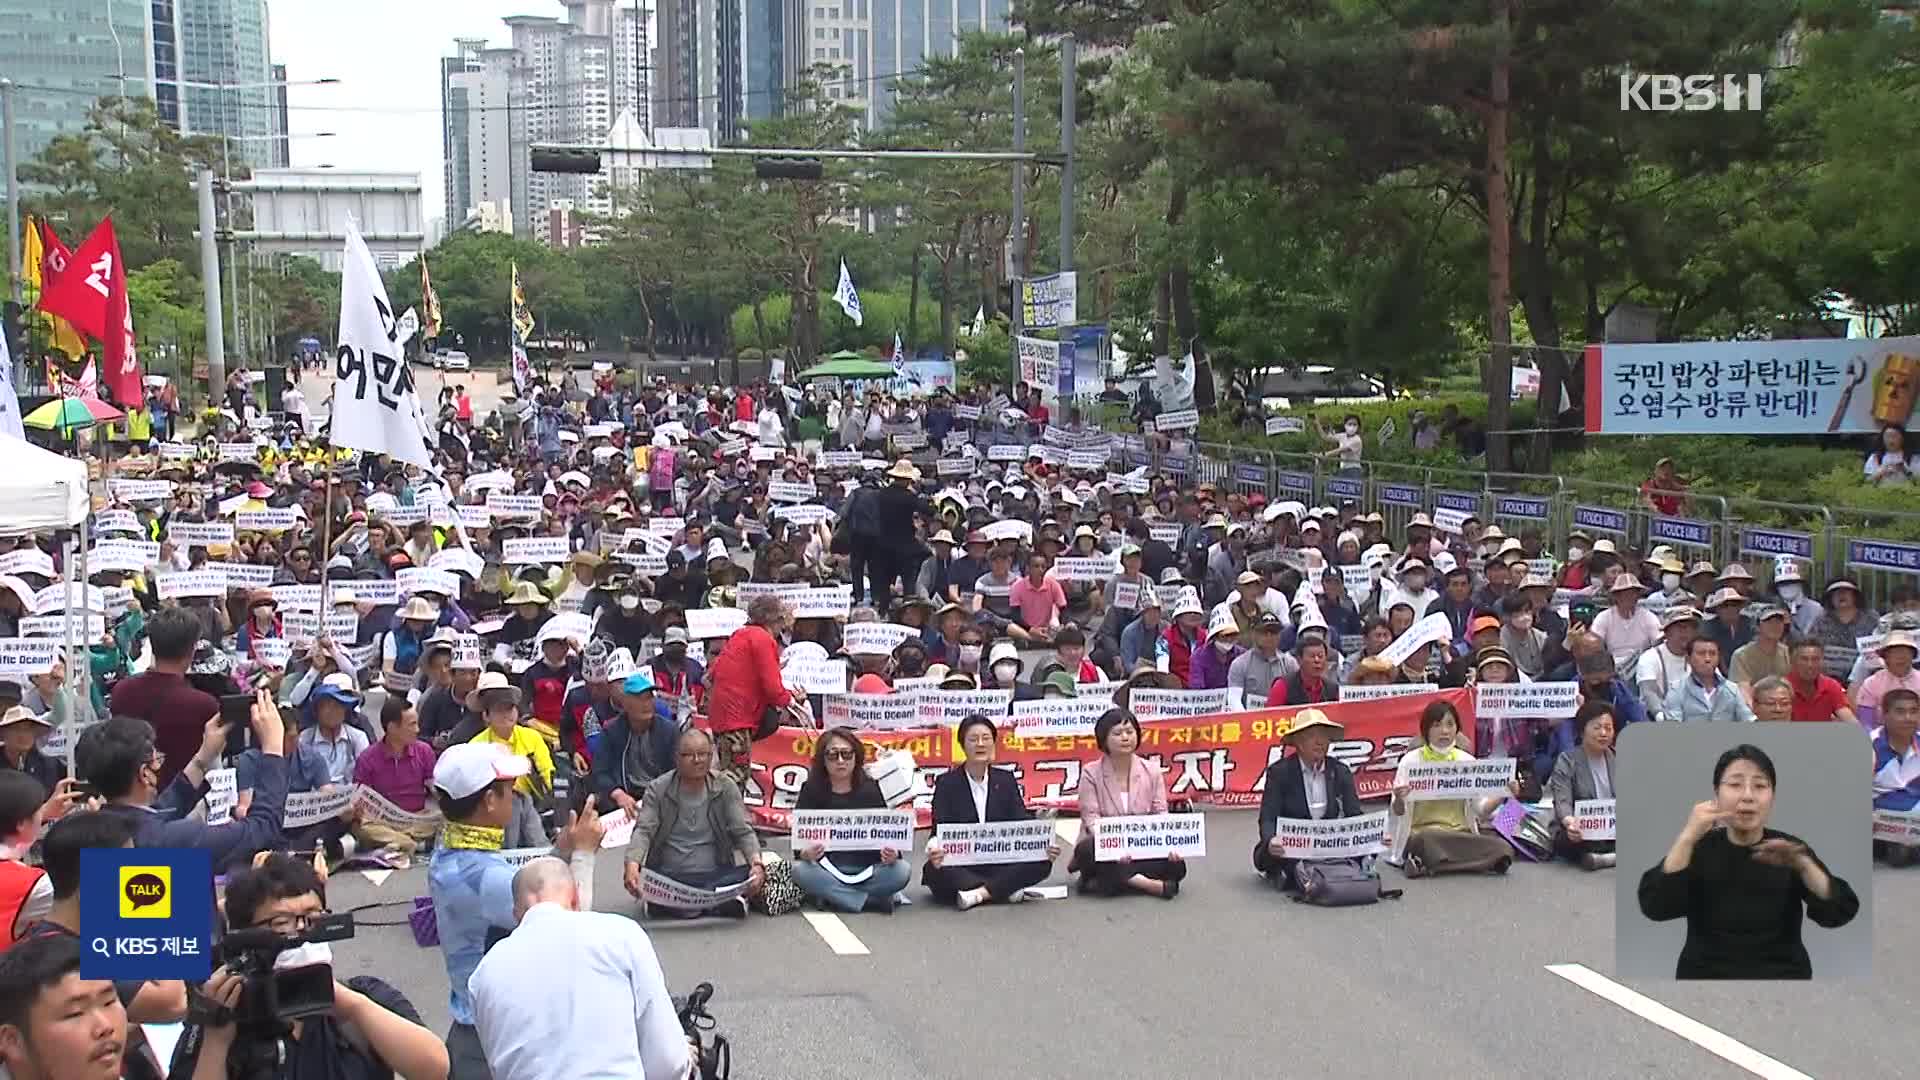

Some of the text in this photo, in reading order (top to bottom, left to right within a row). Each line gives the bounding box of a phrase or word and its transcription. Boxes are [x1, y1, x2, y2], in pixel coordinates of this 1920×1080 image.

[1614, 358, 1840, 389] 국민 밥상 파탄내는
[1614, 389, 1817, 419] 오염수 방류 반대!
[1582, 511, 1617, 528] POLICE LINE
[1662, 521, 1700, 540] POLICE LINE
[1754, 535, 1799, 552] POLICE LINE
[1863, 547, 1918, 566] POLICE LINE
[19, 654, 53, 665] Ocean!
[1159, 704, 1193, 716] Pacific
[1508, 699, 1541, 709] Pacific
[1543, 698, 1575, 708] Ocean!
[850, 709, 882, 721] Pacific
[884, 709, 915, 720] Ocean!
[944, 706, 975, 718] Pacific
[1045, 716, 1078, 727] Pacific
[1168, 720, 1242, 745] 저지를
[1436, 777, 1472, 790] Pacific
[1474, 776, 1509, 788] Ocean!
[1580, 819, 1606, 829] SOS!!
[797, 828, 908, 840] SOS!! Pacific Ocean!
[1099, 833, 1200, 849] SOS!! Pacific Ocean!
[1281, 831, 1384, 848] SOS!! Pacific Ocean!
[973, 840, 1012, 853] Pacific
[1014, 838, 1051, 851] Ocean!
